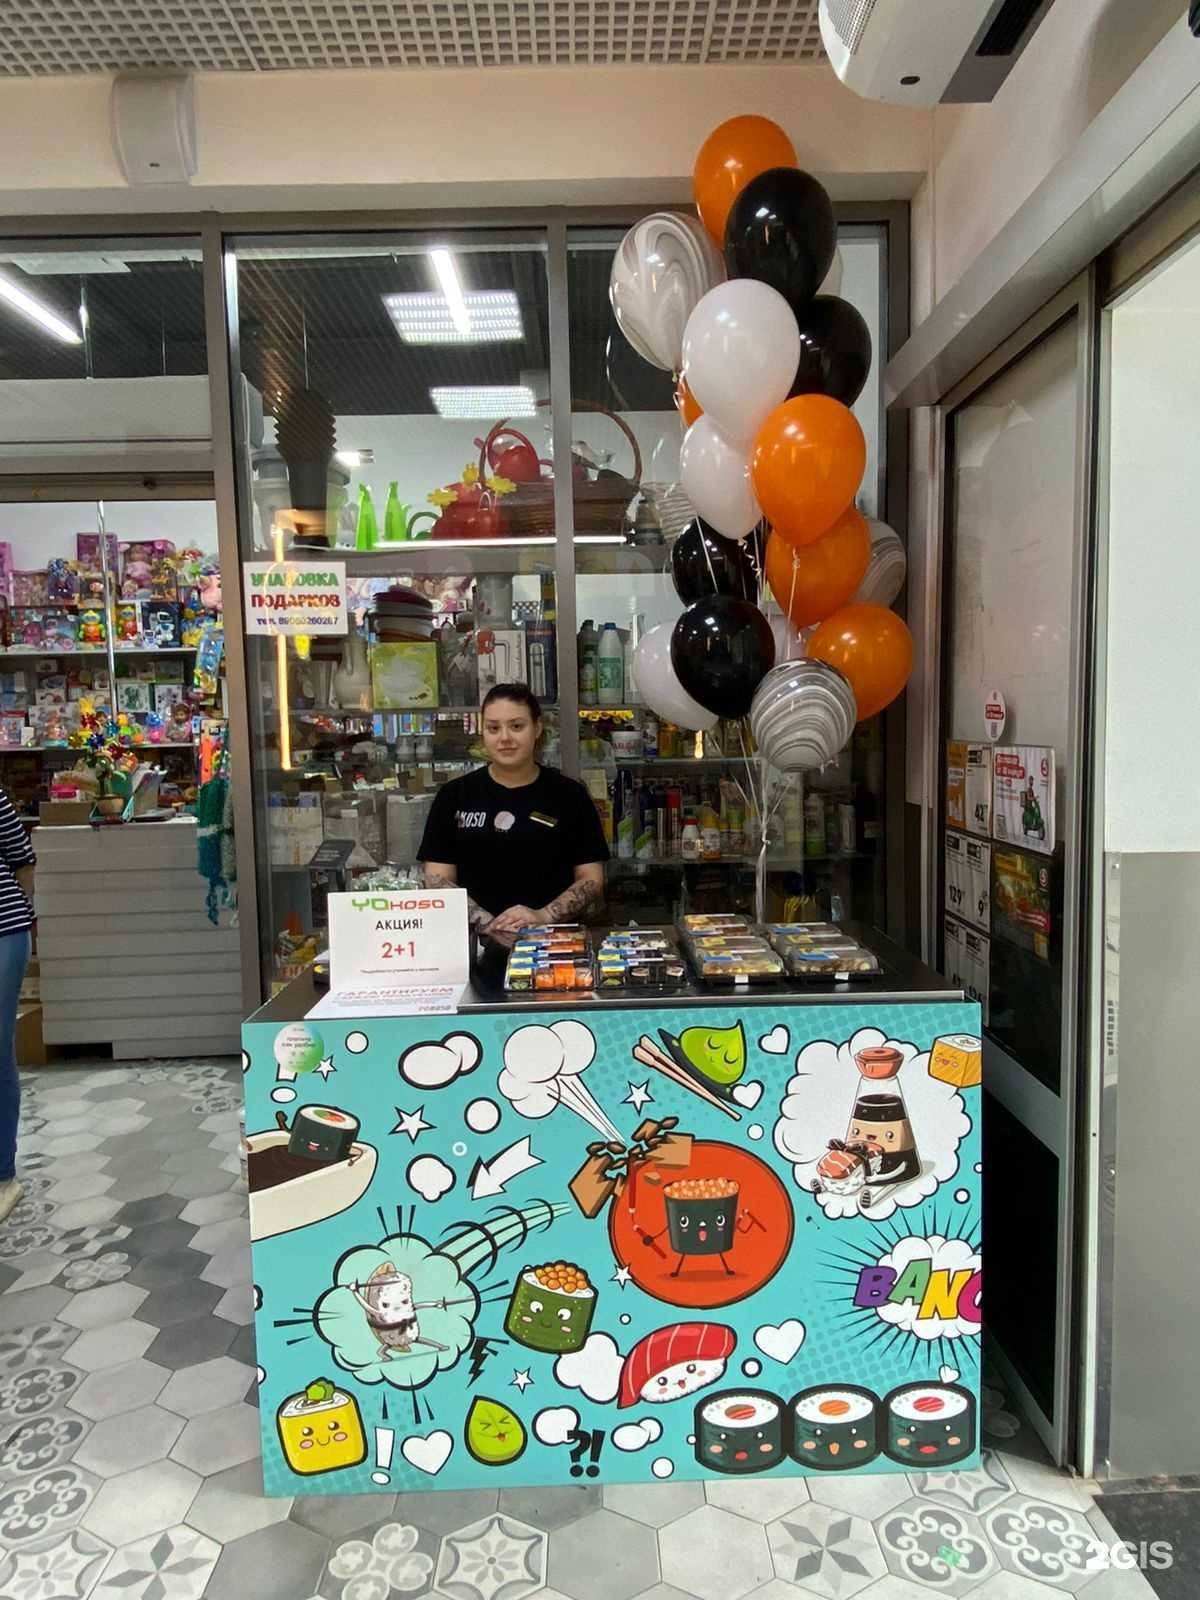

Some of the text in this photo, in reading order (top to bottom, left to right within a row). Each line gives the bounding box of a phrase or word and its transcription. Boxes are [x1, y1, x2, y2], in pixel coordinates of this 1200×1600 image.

[251, 573, 339, 586] УПАОВКА
[376, 918, 423, 931] АКЦИЯ!
[381, 941, 416, 959] 2+1
